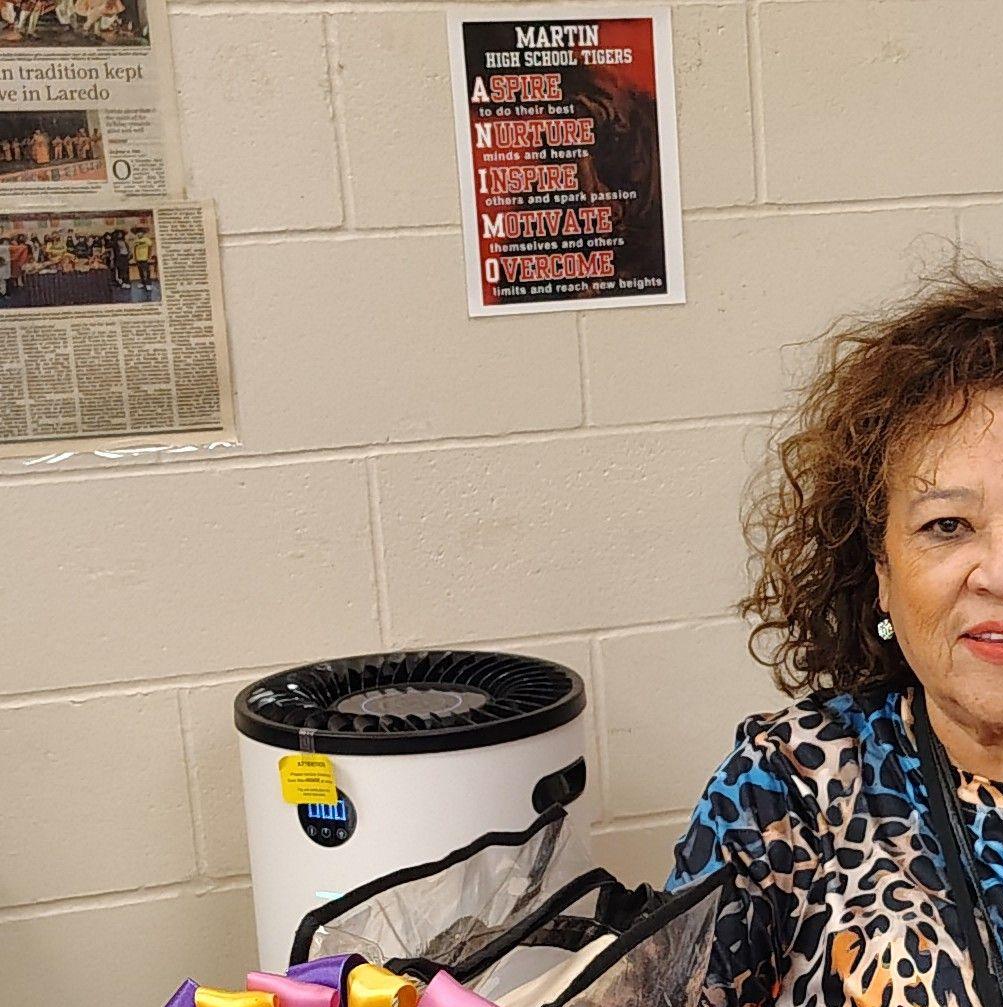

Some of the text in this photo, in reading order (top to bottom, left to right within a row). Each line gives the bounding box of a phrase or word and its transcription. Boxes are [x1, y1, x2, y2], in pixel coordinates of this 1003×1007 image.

[515, 24, 599, 48] MARTIN
[485, 48, 632, 68] HIGH SCHOOL TIGERS
[19, 63, 99, 80] tradition
[104, 62, 144, 83] kept
[23, 85, 40, 101] in
[47, 84, 110, 101] Laredo
[471, 73, 562, 103] ASPIRE
[479, 104, 574, 117] to do their best
[476, 118, 595, 148] NURTURE
[483, 148, 589, 162] minds and hearts
[478, 164, 578, 194] INSPIRE
[485, 190, 637, 206] others and spark passion
[481, 207, 612, 238] MOTIVATE
[490, 236, 625, 252] themselves and others
[484, 250, 615, 284] OVERCOME
[493, 276, 663, 297] limits and reach new heights
